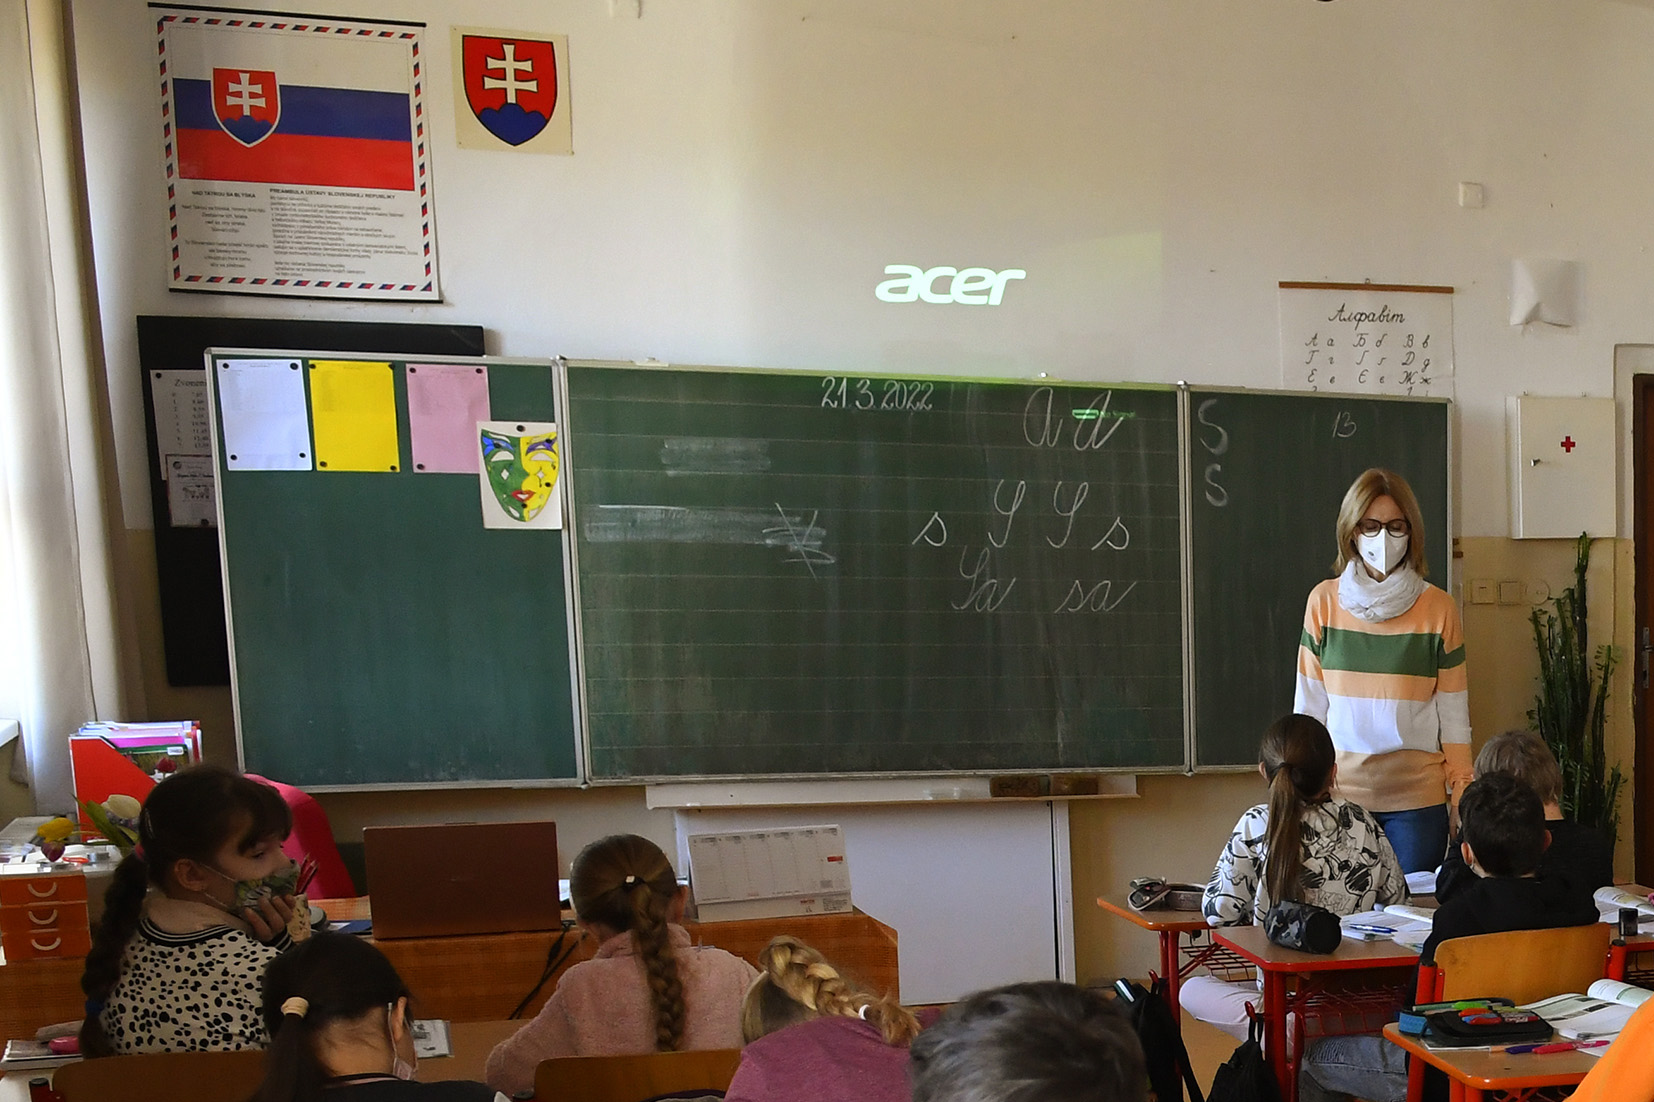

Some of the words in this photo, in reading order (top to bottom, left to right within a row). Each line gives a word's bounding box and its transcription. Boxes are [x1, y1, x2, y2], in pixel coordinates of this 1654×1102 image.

[875, 264, 1027, 306] acer
[1327, 302, 1406, 331] Алфавіт
[1304, 332, 1319, 347] А
[1326, 337, 1335, 347] а
[1352, 332, 1369, 347] Б
[1375, 333, 1388, 348] б
[1402, 333, 1414, 348] В
[1422, 334, 1430, 348] в
[1304, 349, 1320, 365] Г
[1401, 350, 1416, 366] Д
[1398, 370, 1419, 385] Ж
[1419, 377, 1432, 385] ж
[1054, 579, 1138, 614] sa
